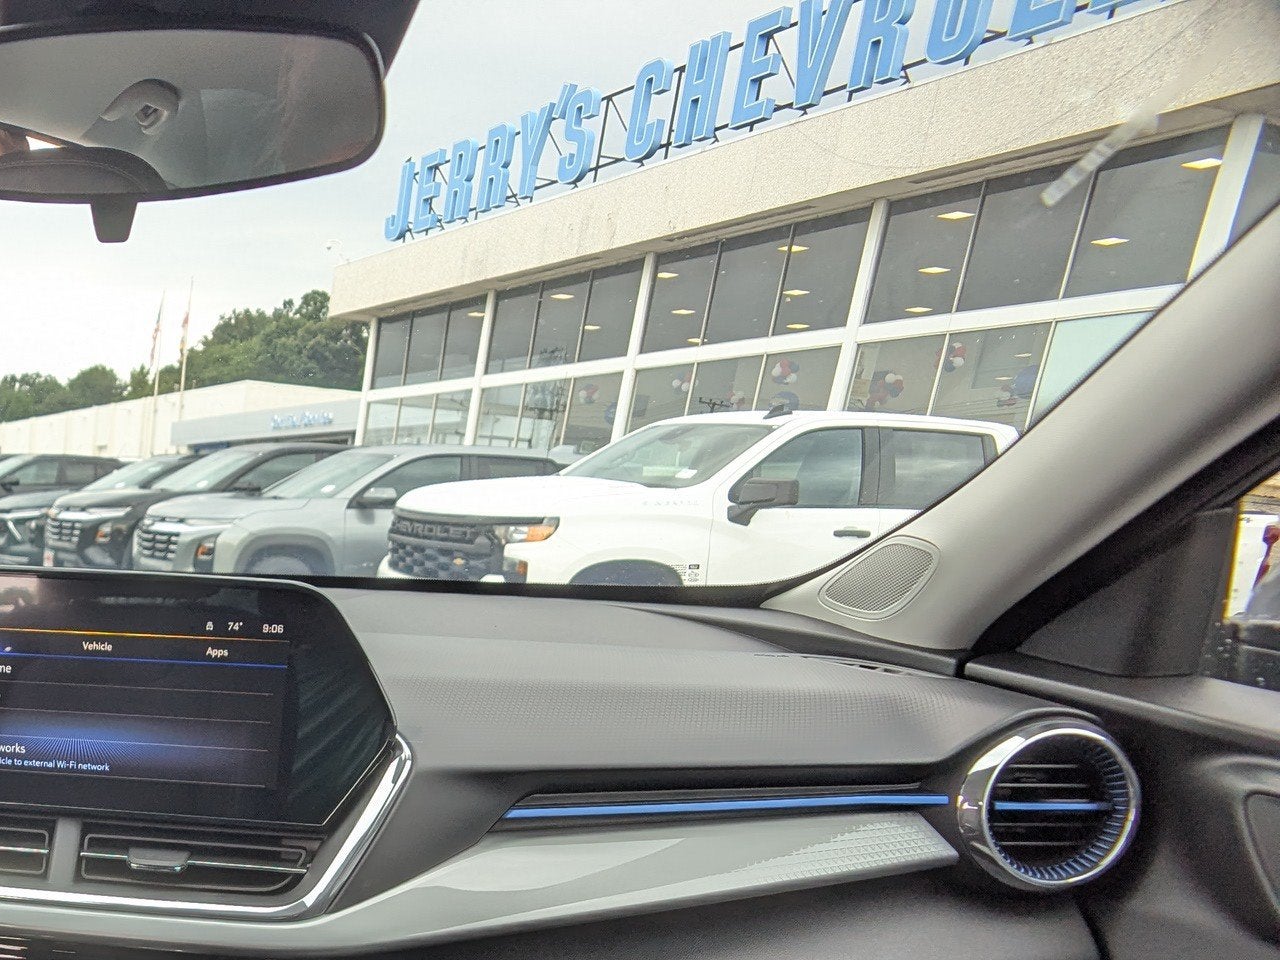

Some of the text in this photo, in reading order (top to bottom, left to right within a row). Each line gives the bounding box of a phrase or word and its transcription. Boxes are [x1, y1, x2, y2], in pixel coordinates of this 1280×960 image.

[384, 0, 1136, 242] JERRY'S CHEVR
[82, 641, 113, 651] Vehicle
[206, 646, 229, 658] Apps
[14, 757, 22, 766] to
[24, 758, 55, 768] external
[56, 760, 77, 769] Wi-Fi
[78, 762, 110, 771] network
